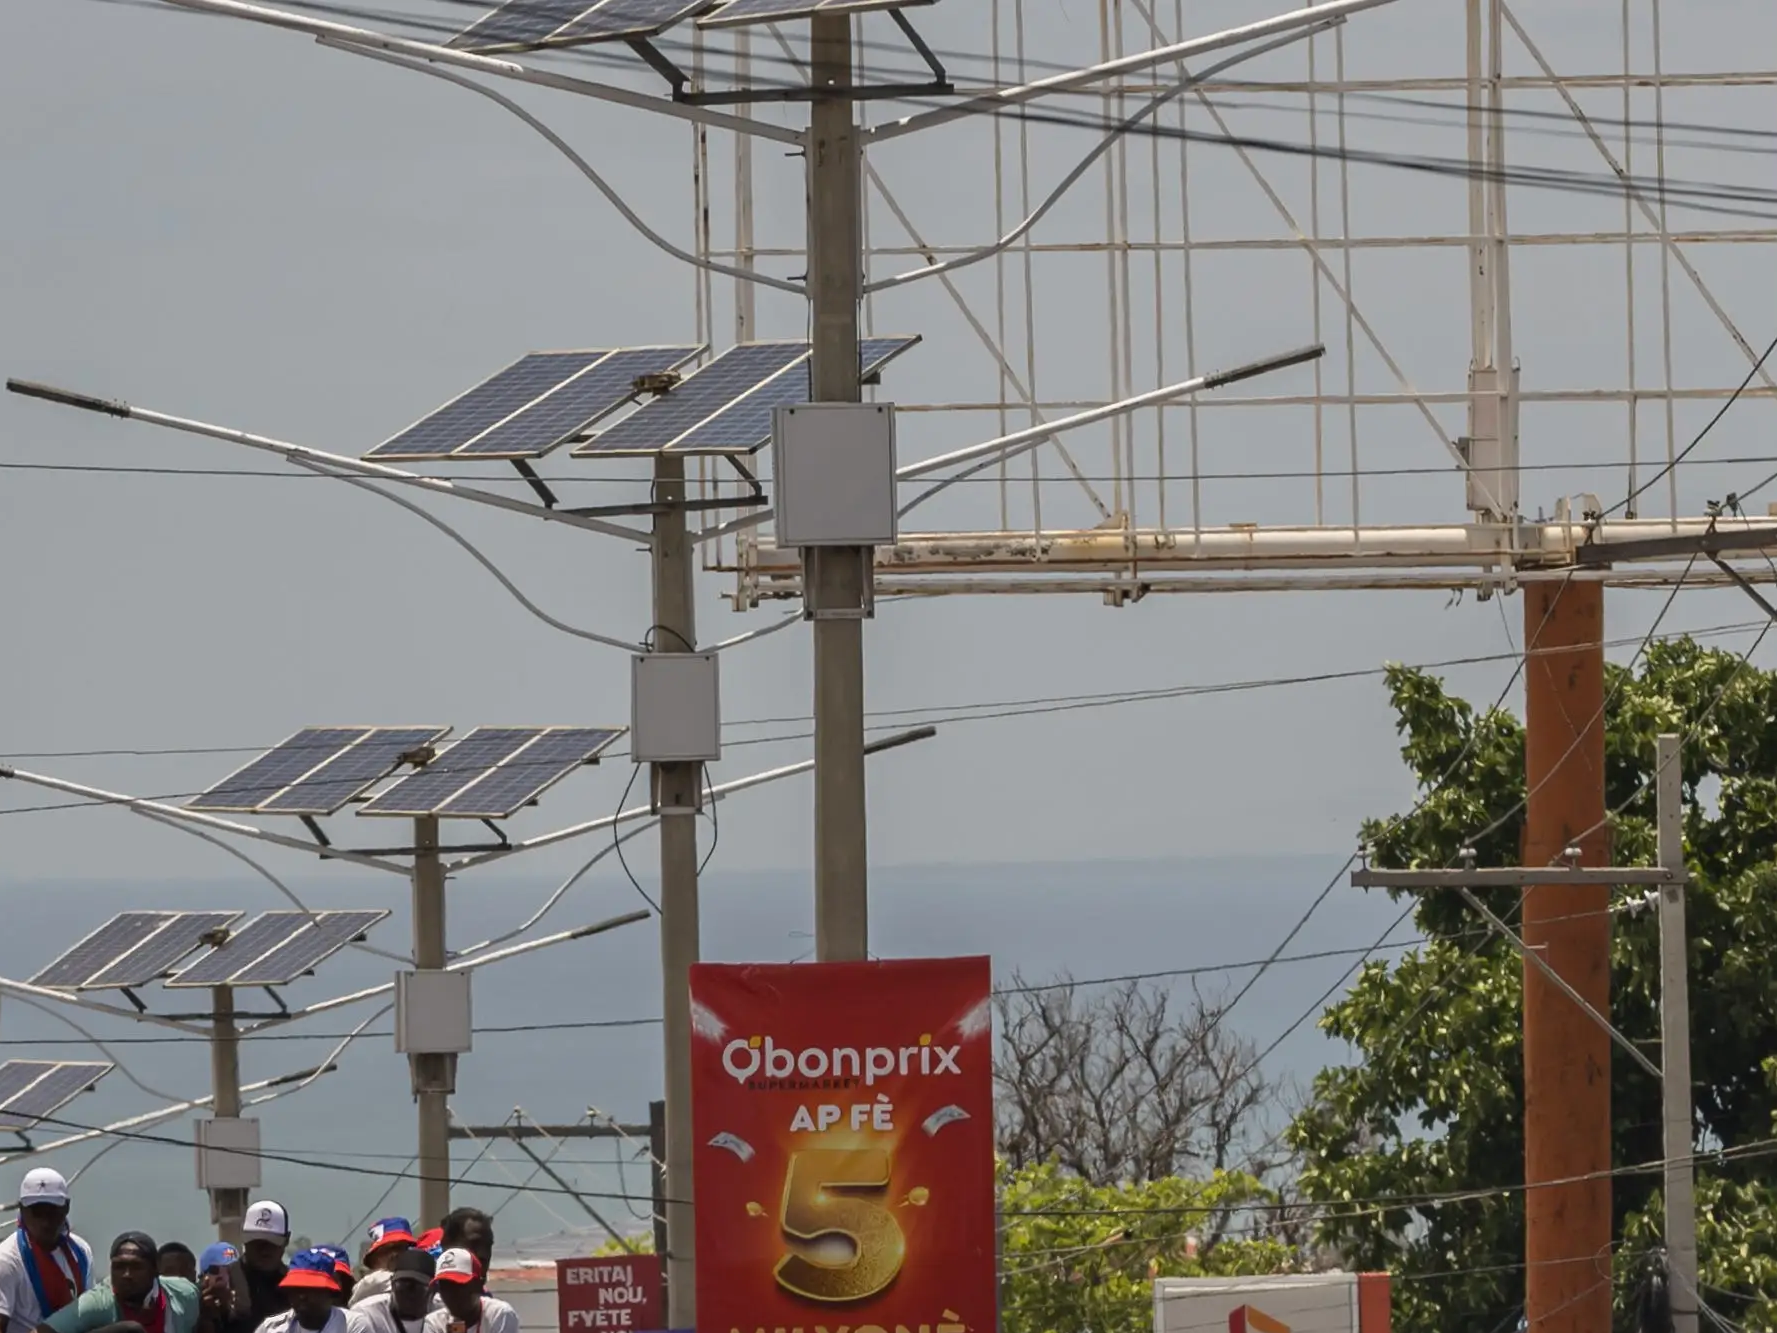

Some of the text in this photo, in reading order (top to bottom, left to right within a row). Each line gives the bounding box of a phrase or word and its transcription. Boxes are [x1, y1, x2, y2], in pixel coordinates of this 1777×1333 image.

[789, 1093, 895, 1132] AP FÈ
[772, 1147, 906, 1303] 5
[565, 1265, 634, 1287] ERITAJ
[598, 1286, 647, 1305] NOU,
[567, 1307, 633, 1328] FYÈTE
